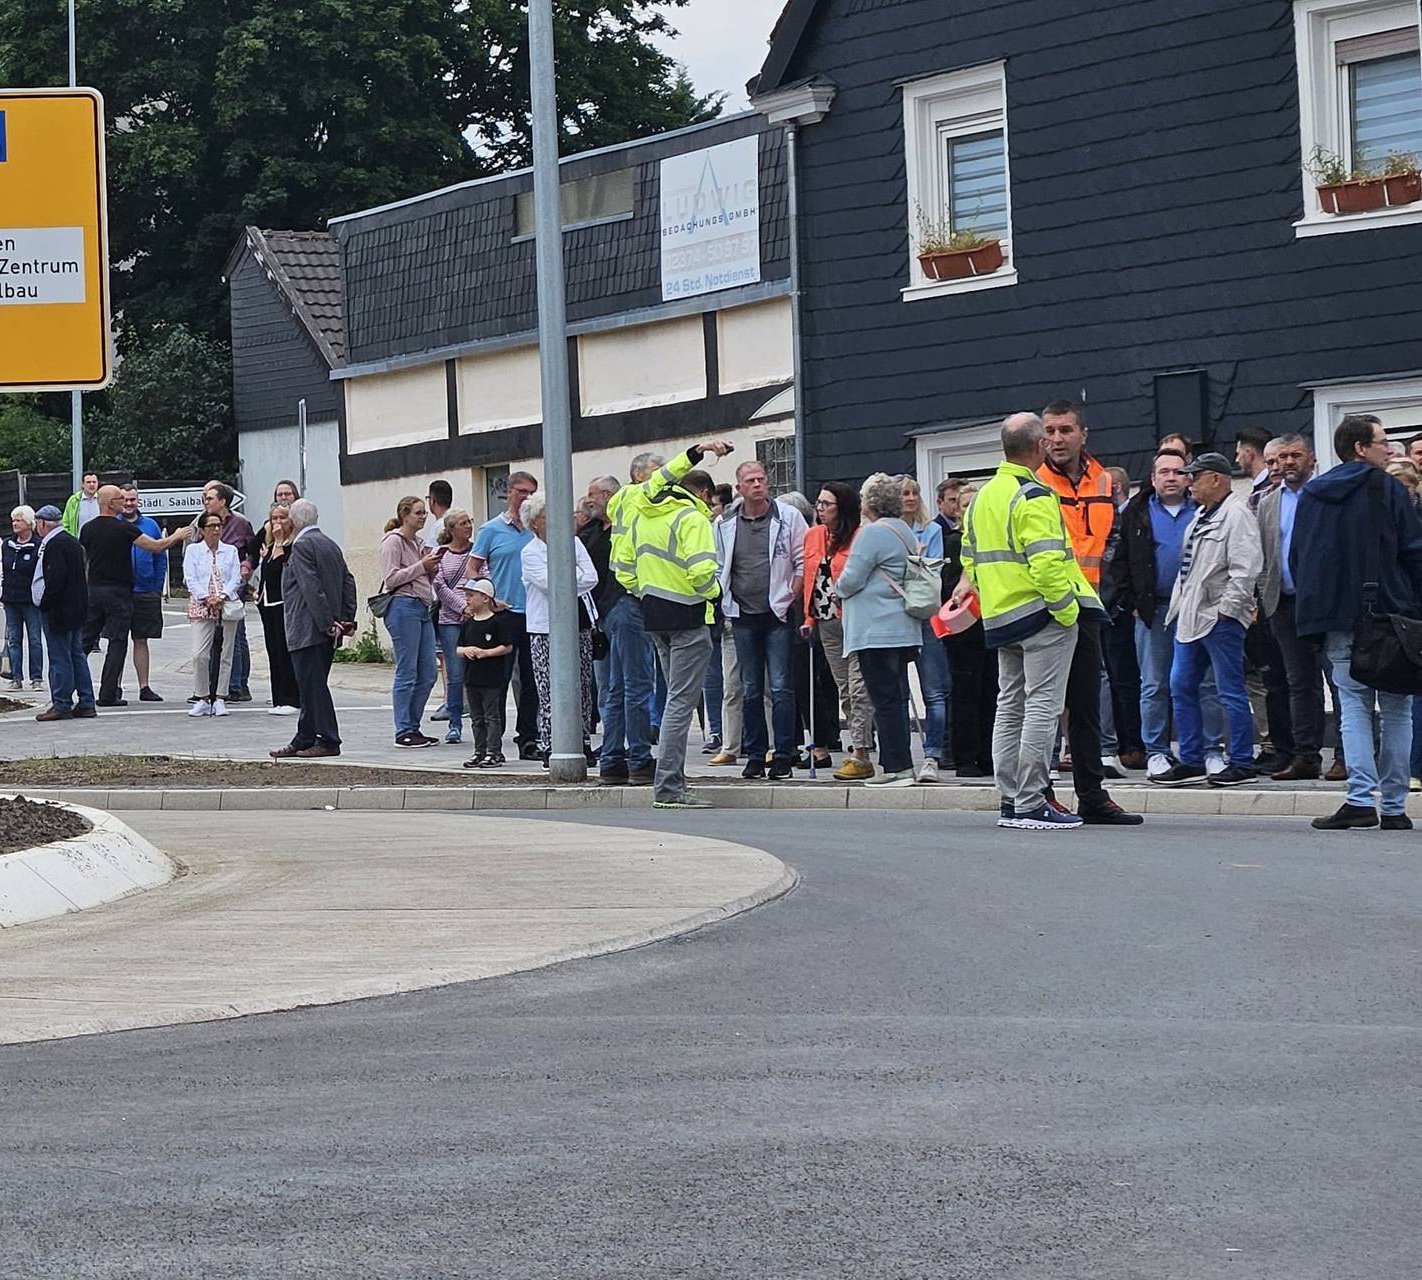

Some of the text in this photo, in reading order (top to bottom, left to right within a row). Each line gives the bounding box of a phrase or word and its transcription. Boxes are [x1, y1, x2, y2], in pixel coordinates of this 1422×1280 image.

[663, 178, 756, 223] LUDWIG
[728, 207, 756, 221] GMBH
[665, 279, 680, 295] 24
[705, 266, 755, 287] Notdienst
